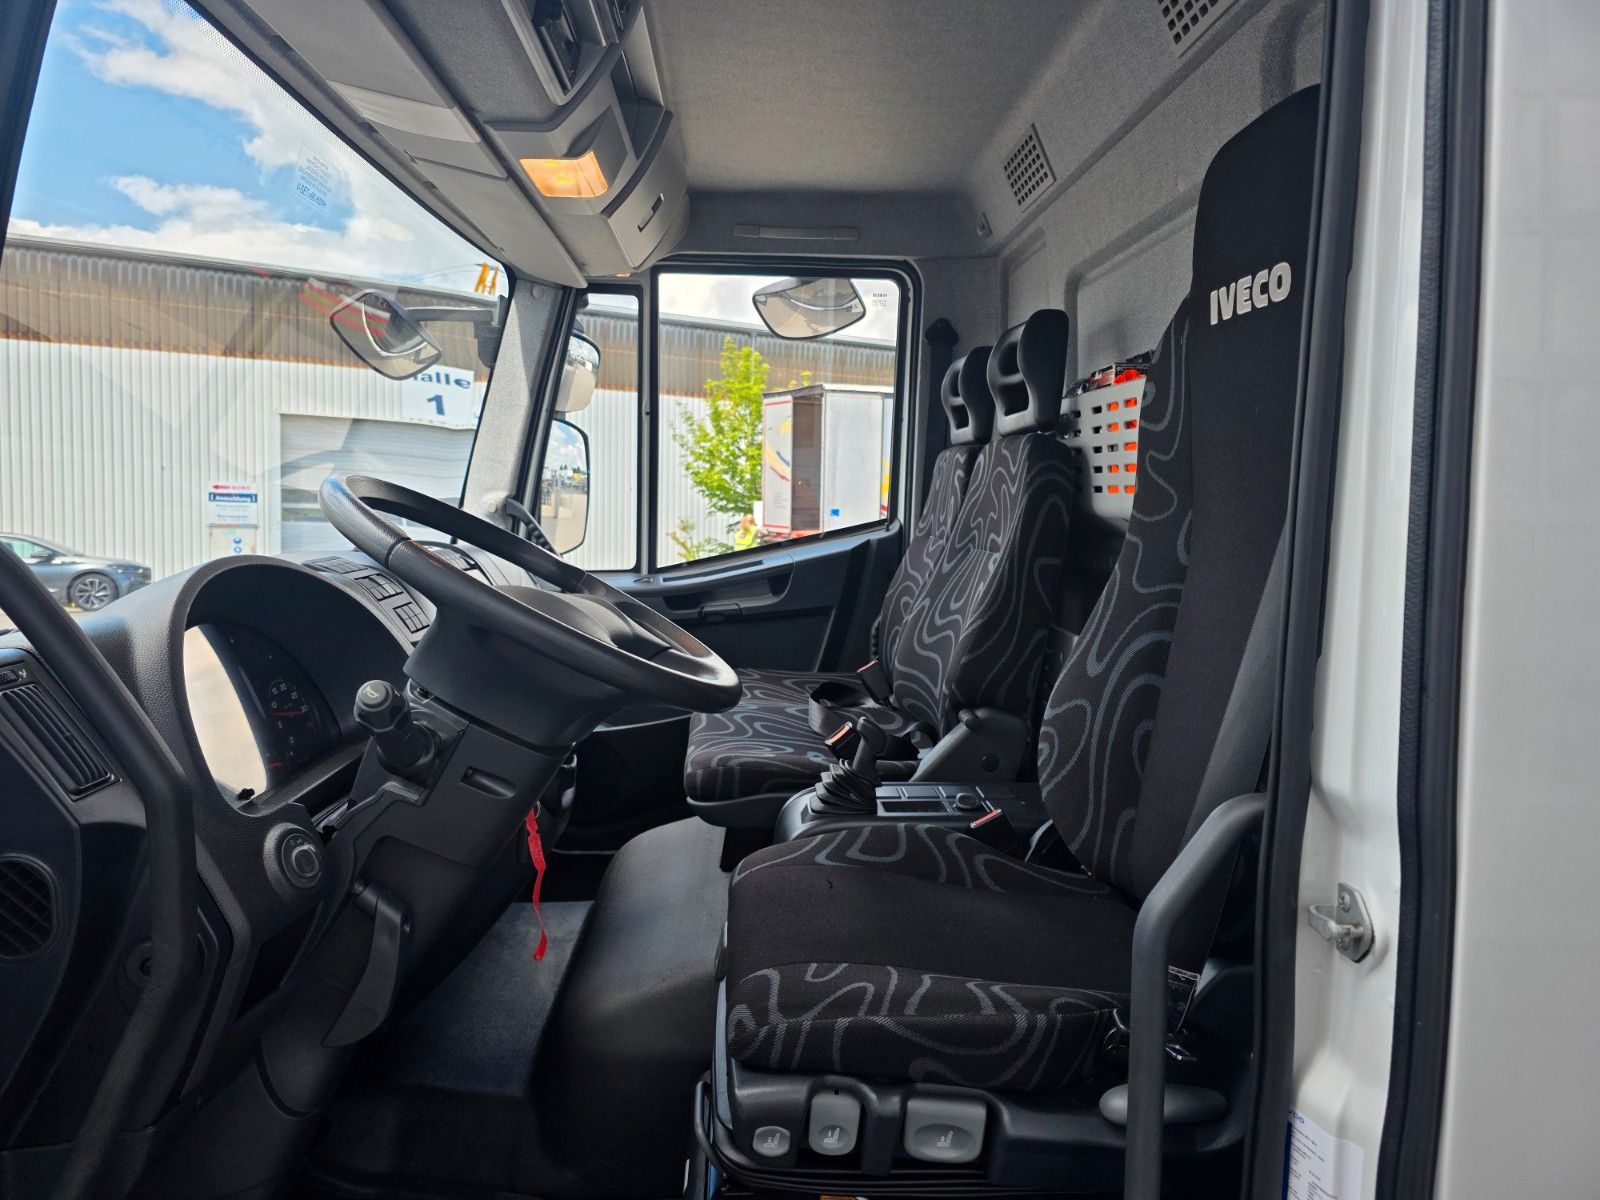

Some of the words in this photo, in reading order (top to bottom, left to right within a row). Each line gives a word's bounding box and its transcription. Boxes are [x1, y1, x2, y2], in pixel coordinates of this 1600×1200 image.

[1210, 261, 1292, 325] IVECO
[413, 371, 471, 389] alle
[427, 394, 445, 416] 1
